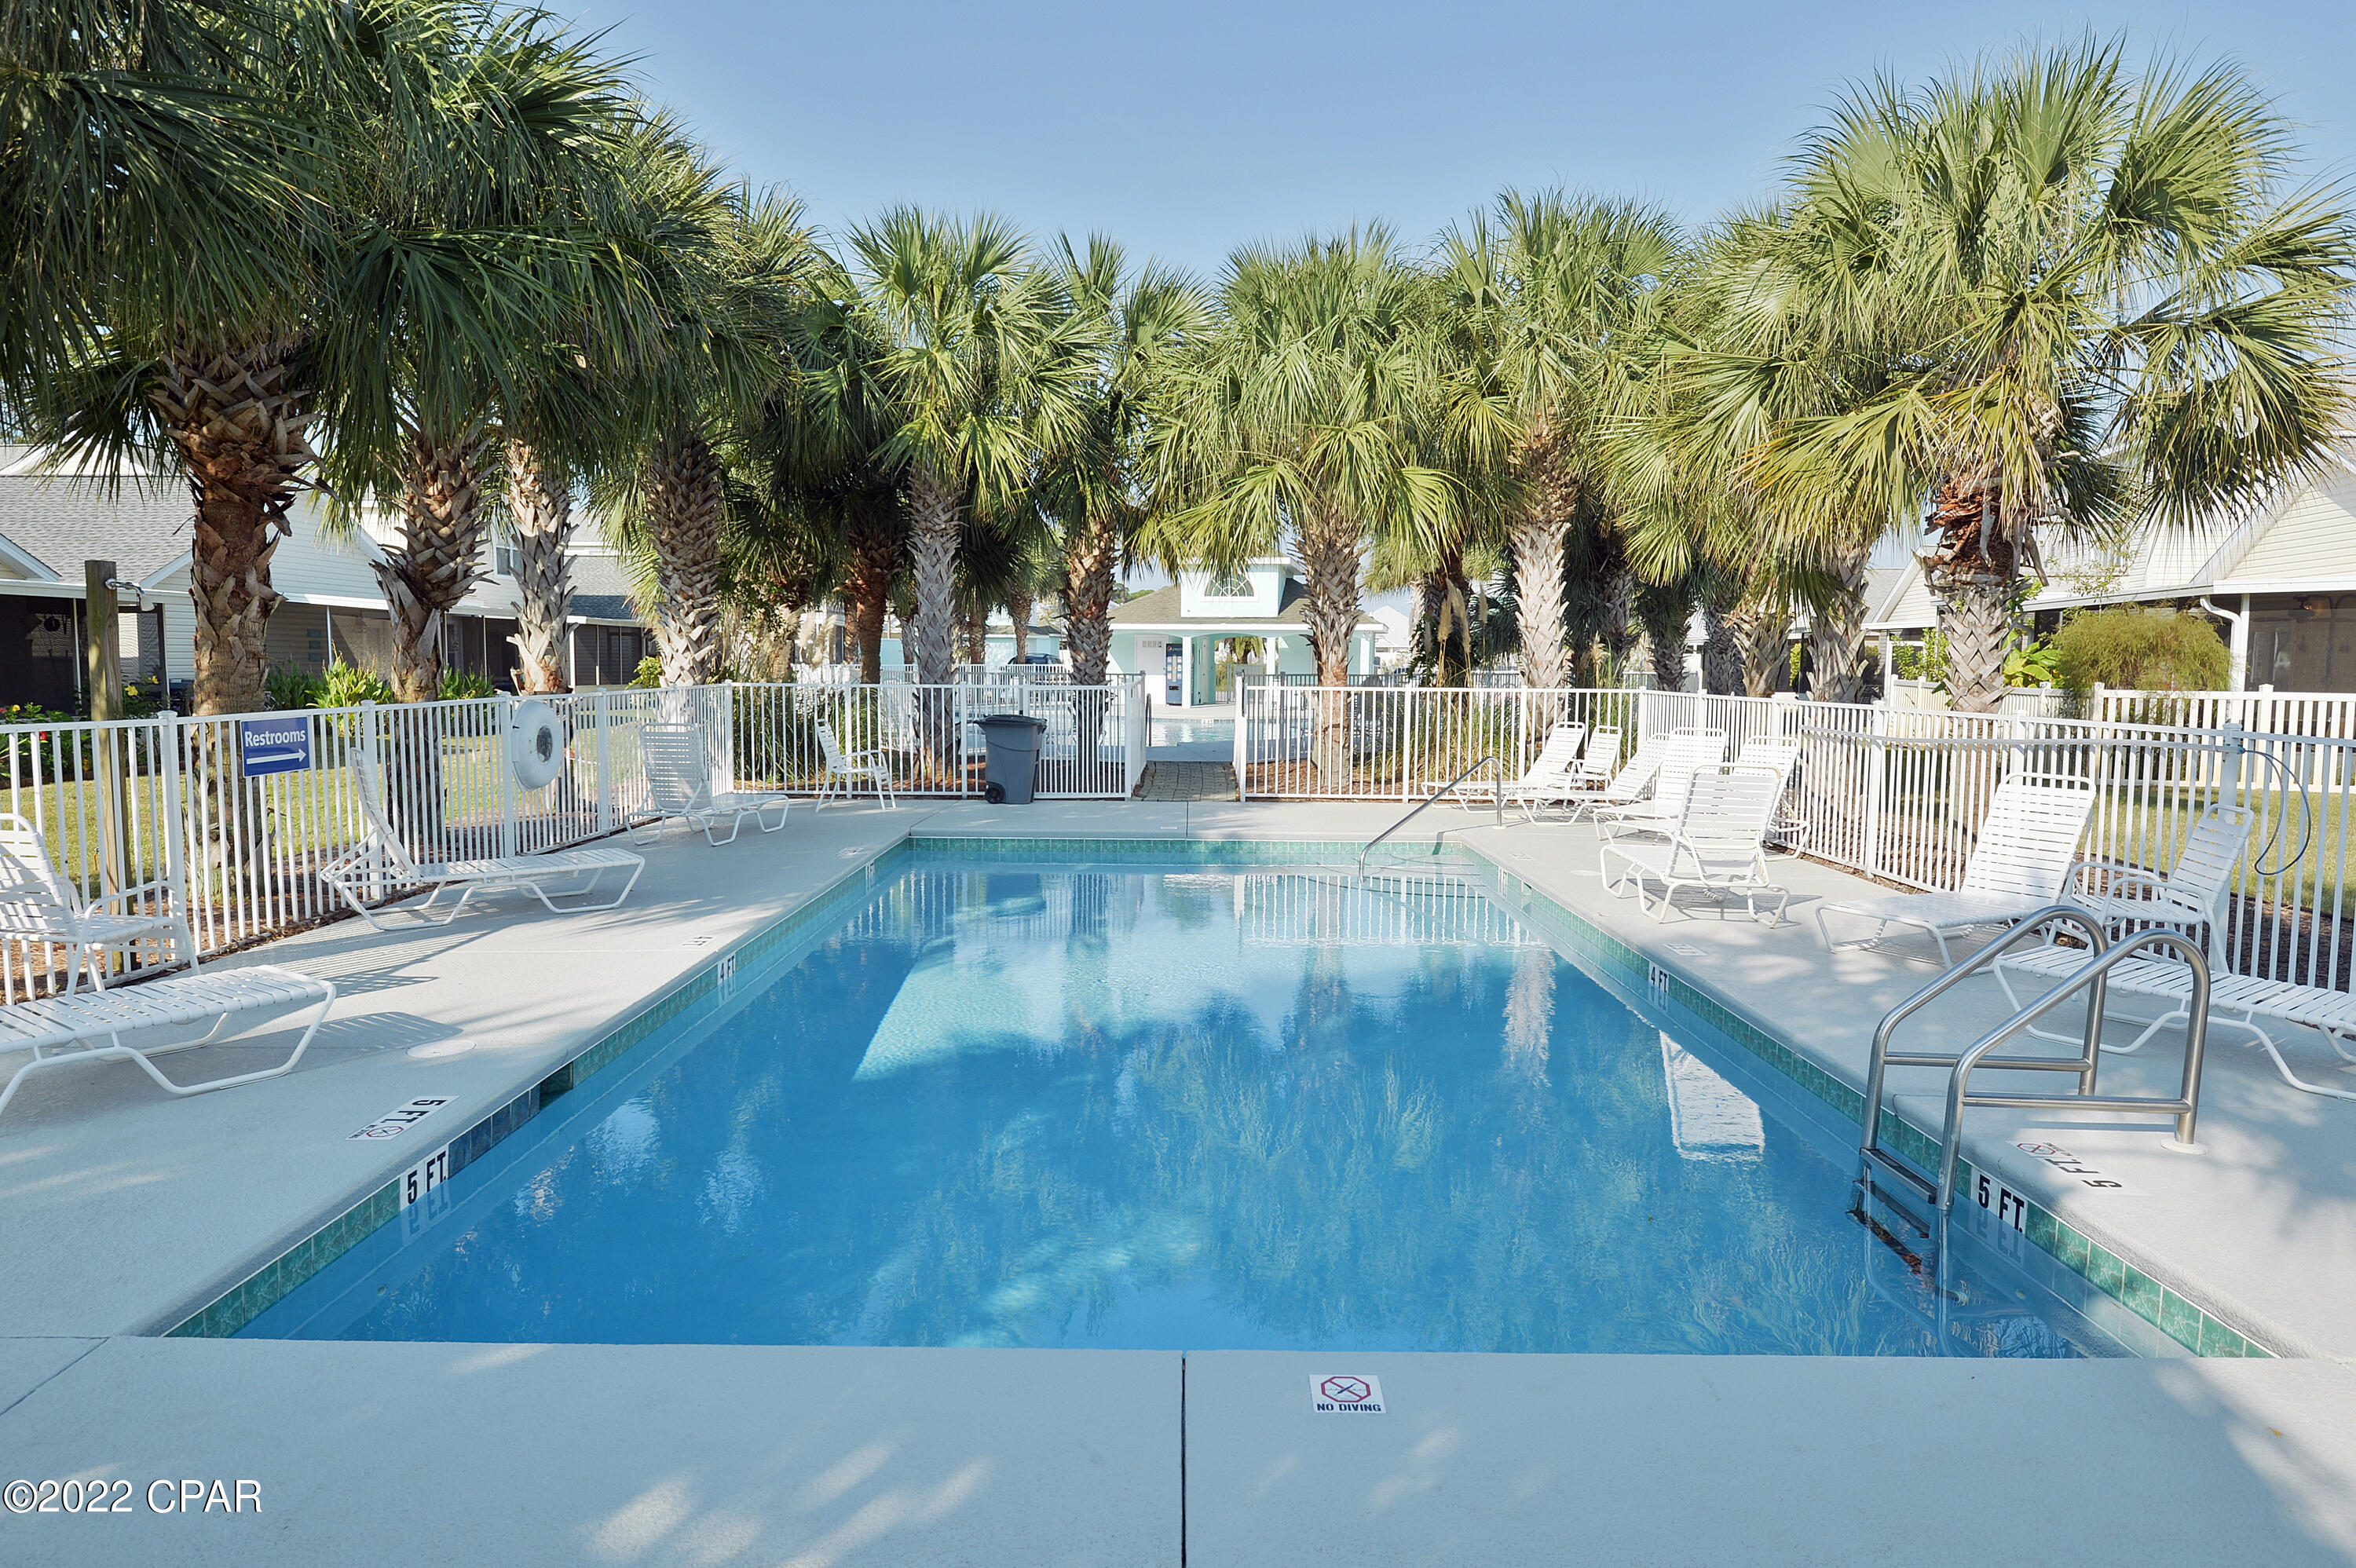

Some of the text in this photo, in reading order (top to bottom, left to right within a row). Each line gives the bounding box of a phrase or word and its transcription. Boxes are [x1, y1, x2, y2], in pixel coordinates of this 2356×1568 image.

[244, 729, 306, 747] Restrooms
[1651, 966, 1655, 985] 4
[407, 1169, 418, 1204] 5
[1978, 1174, 1991, 1209] 5
[2080, 1179, 2123, 1188] 5
[1316, 1402, 1381, 1413] NO DIVING
